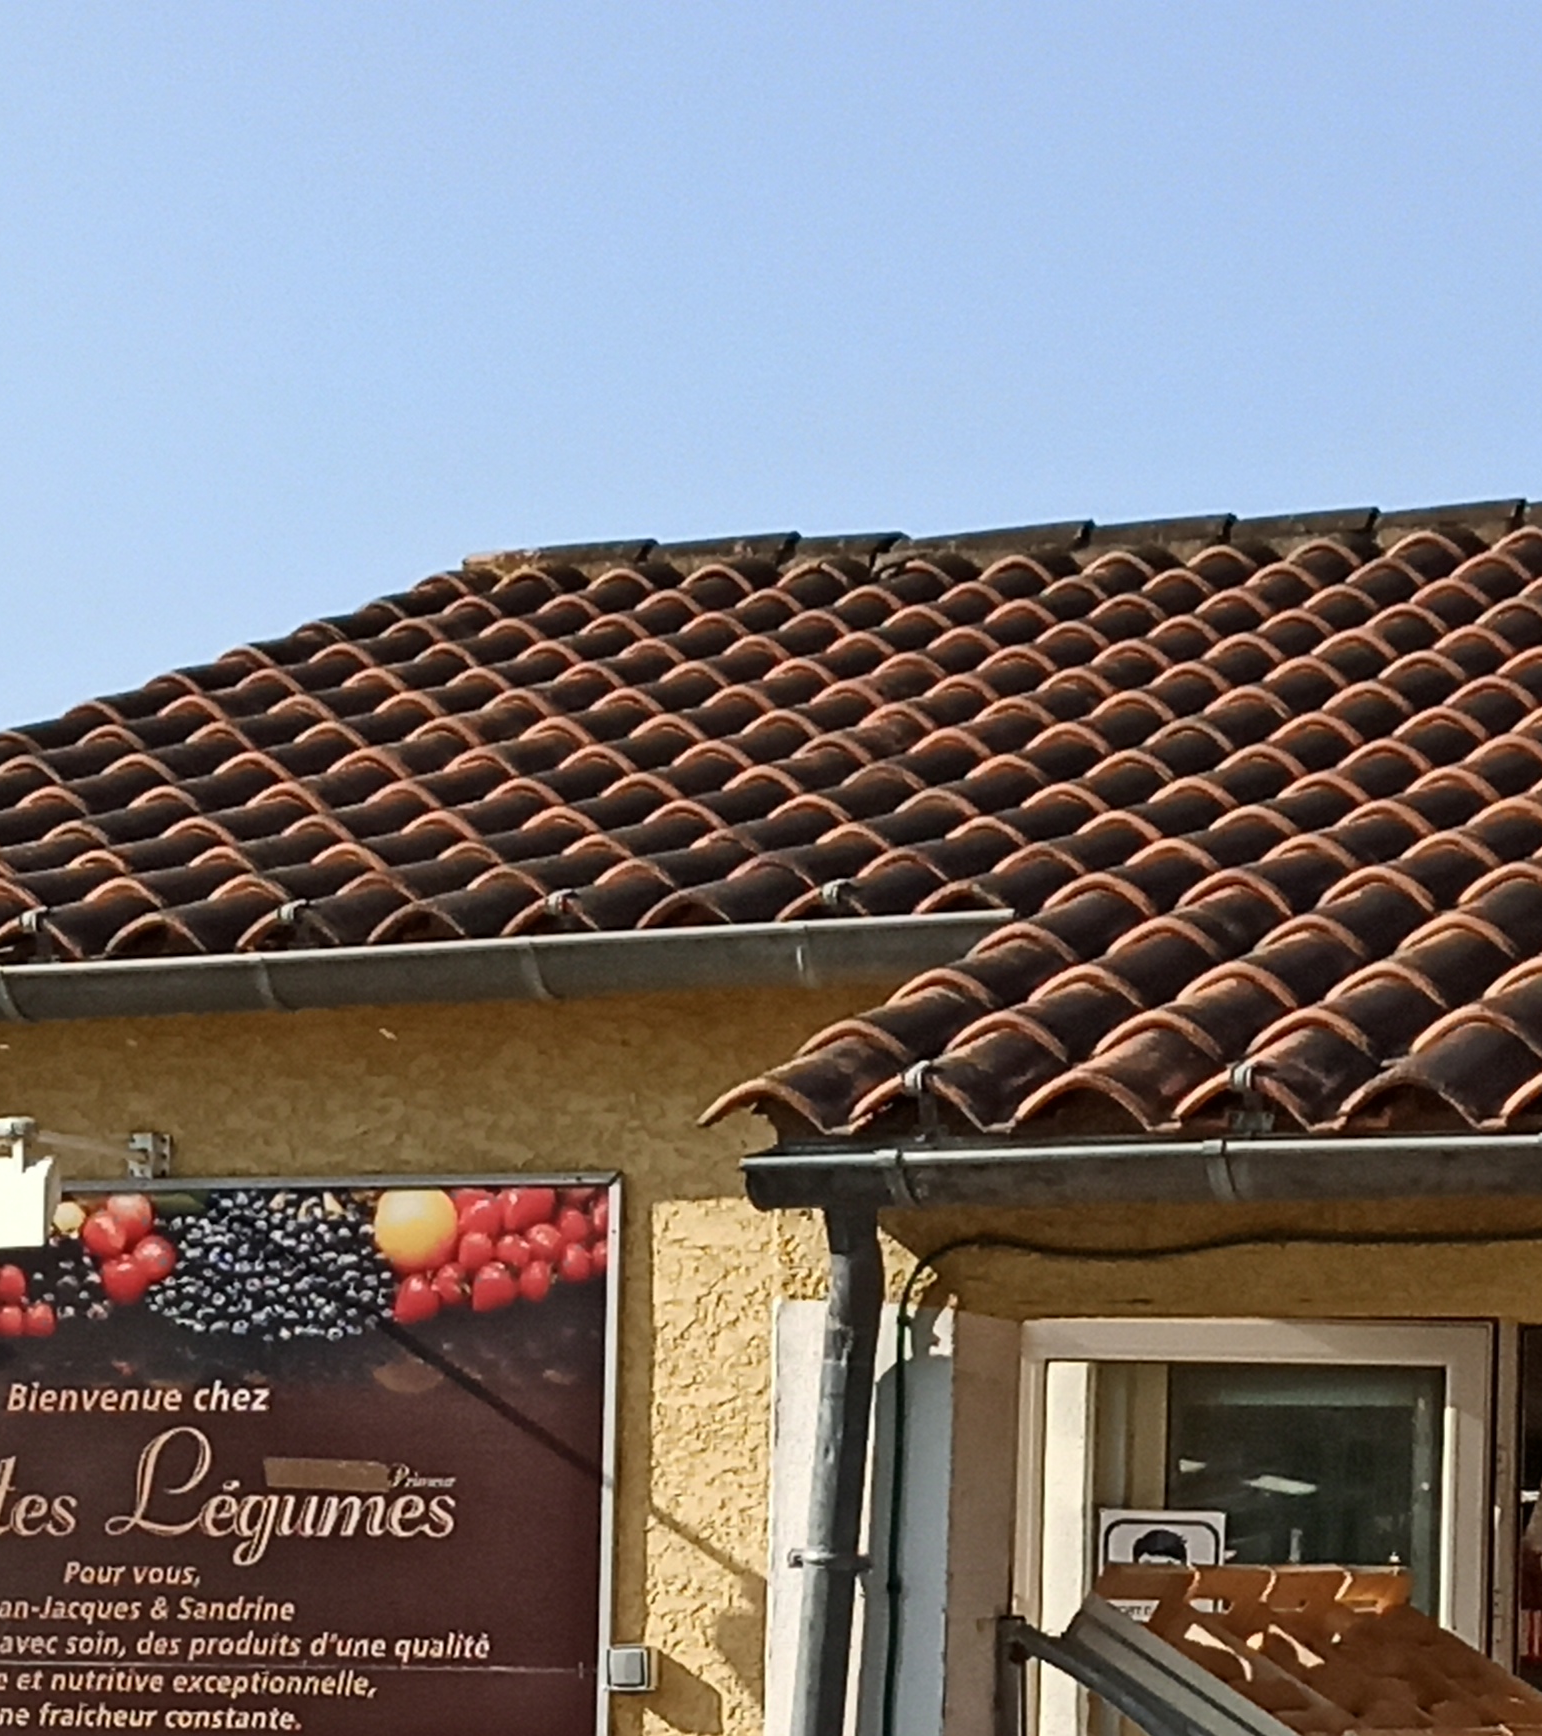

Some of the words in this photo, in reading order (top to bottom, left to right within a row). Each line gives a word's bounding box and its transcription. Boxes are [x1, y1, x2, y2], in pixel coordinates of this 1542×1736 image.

[6, 1381, 183, 1412] Bienvenue
[192, 1380, 270, 1412] chez
[104, 1426, 456, 1566] Légumes
[63, 1561, 125, 1585] Pour
[133, 1565, 201, 1587] vous,
[150, 1597, 169, 1620] &
[176, 1596, 295, 1621] Sandrine
[0, 1633, 59, 1656] avec
[65, 1630, 127, 1659] soin,
[136, 1631, 182, 1656] des
[188, 1631, 302, 1661] produits
[309, 1632, 387, 1658] d'une
[394, 1630, 491, 1664] qualité
[16, 1670, 43, 1692] et
[50, 1669, 164, 1693] nutritive
[172, 1671, 378, 1699] exceptionnelle,
[165, 1706, 303, 1731] constante.
